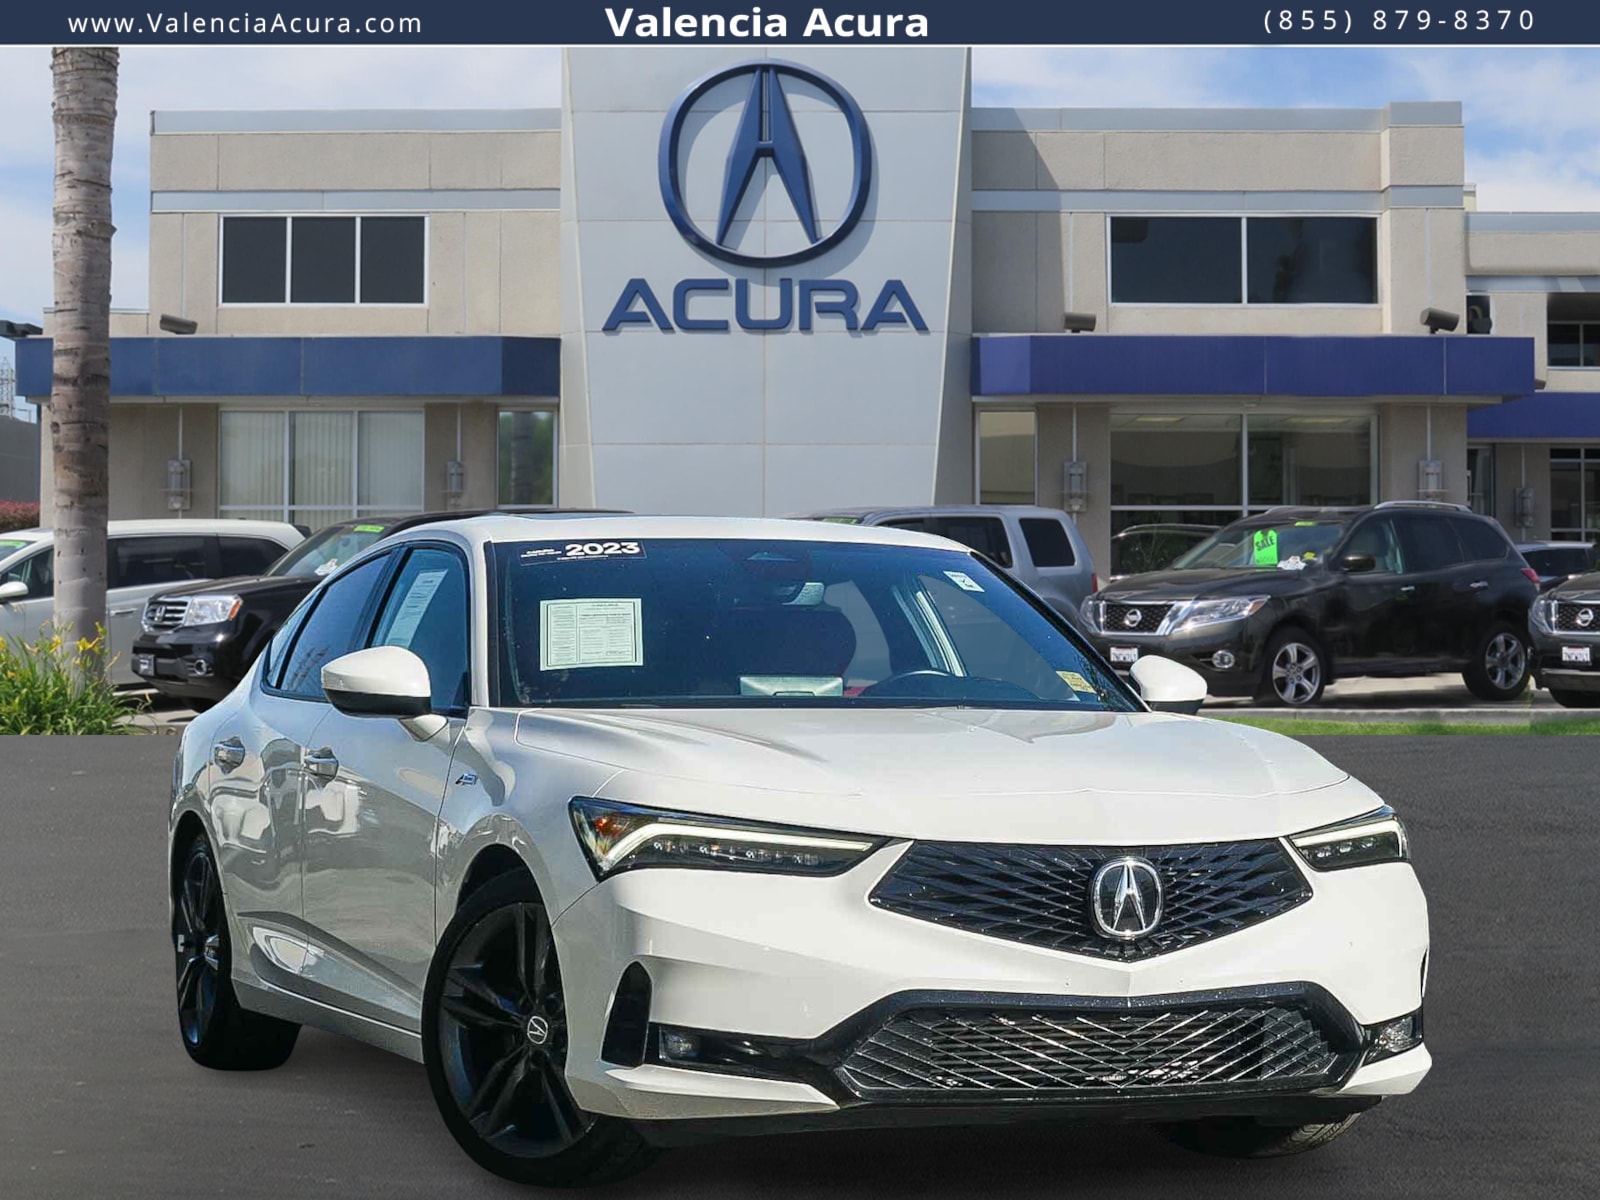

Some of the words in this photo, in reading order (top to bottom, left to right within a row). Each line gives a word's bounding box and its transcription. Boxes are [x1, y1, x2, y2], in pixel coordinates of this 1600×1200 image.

[603, 278, 929, 333] ACURA
[565, 541, 640, 556] 2023
[1254, 535, 1275, 552] SALE
